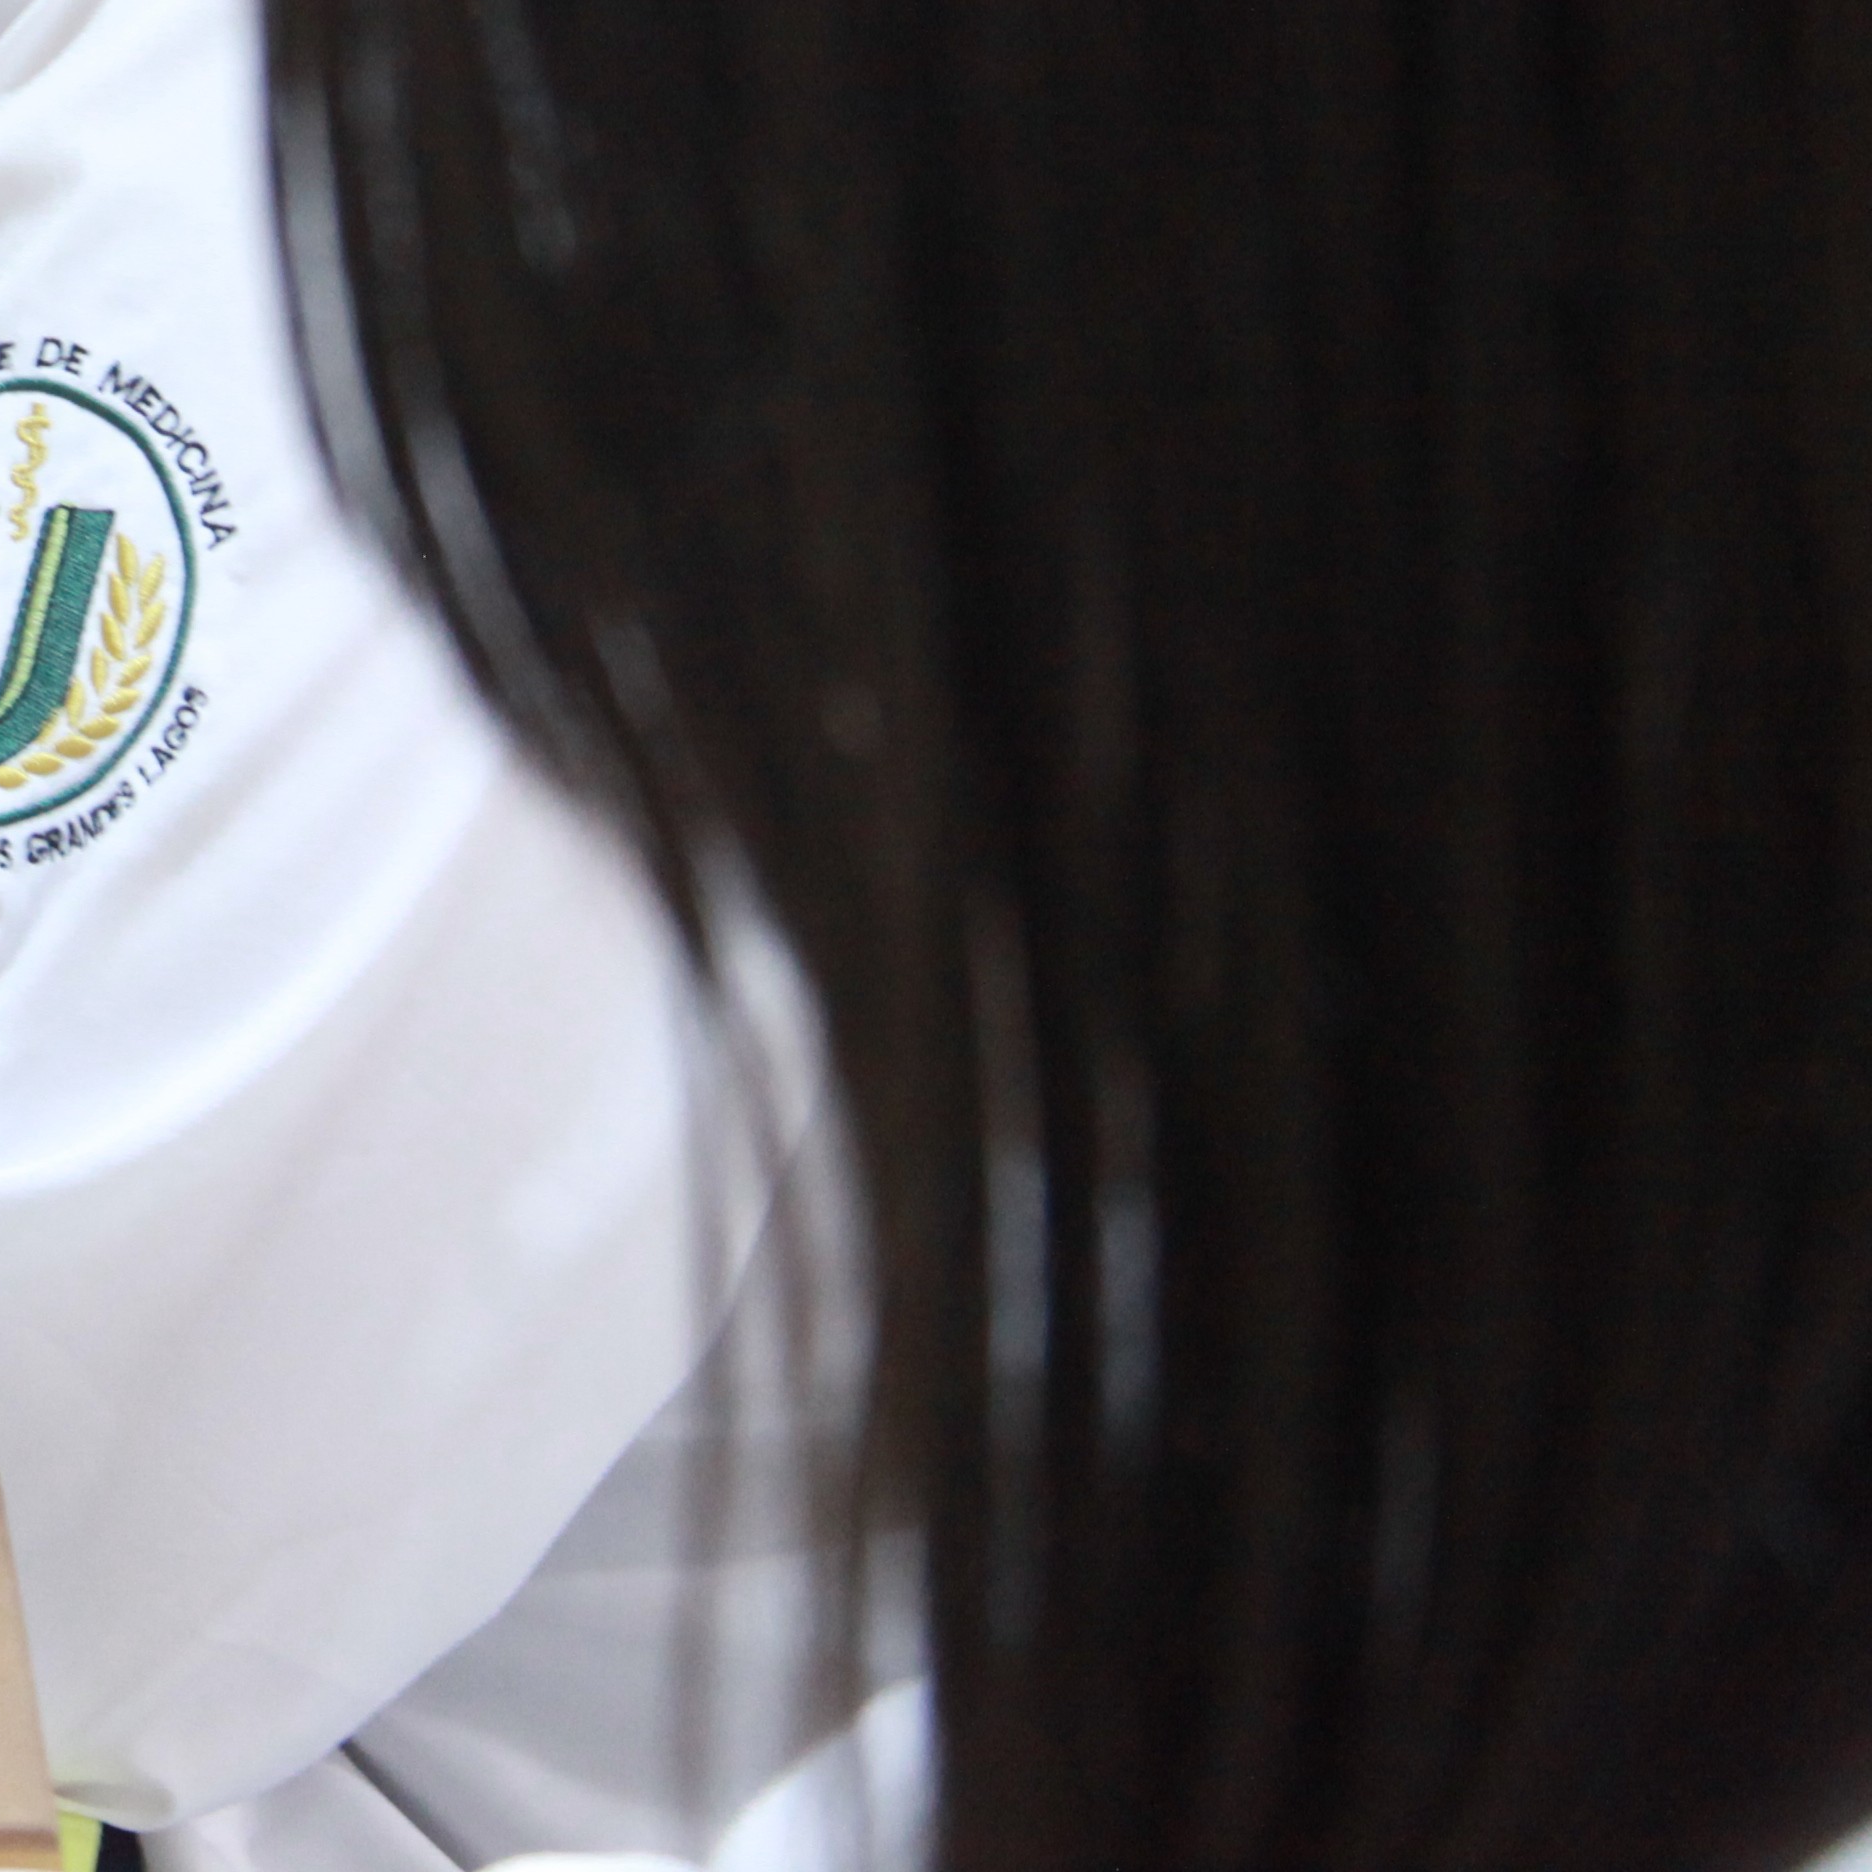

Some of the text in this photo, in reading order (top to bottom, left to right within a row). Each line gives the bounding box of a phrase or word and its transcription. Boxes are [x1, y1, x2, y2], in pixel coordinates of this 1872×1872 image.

[36, 336, 90, 377] DE
[97, 360, 239, 551] MEDICINA
[137, 685, 209, 786] LAGOS
